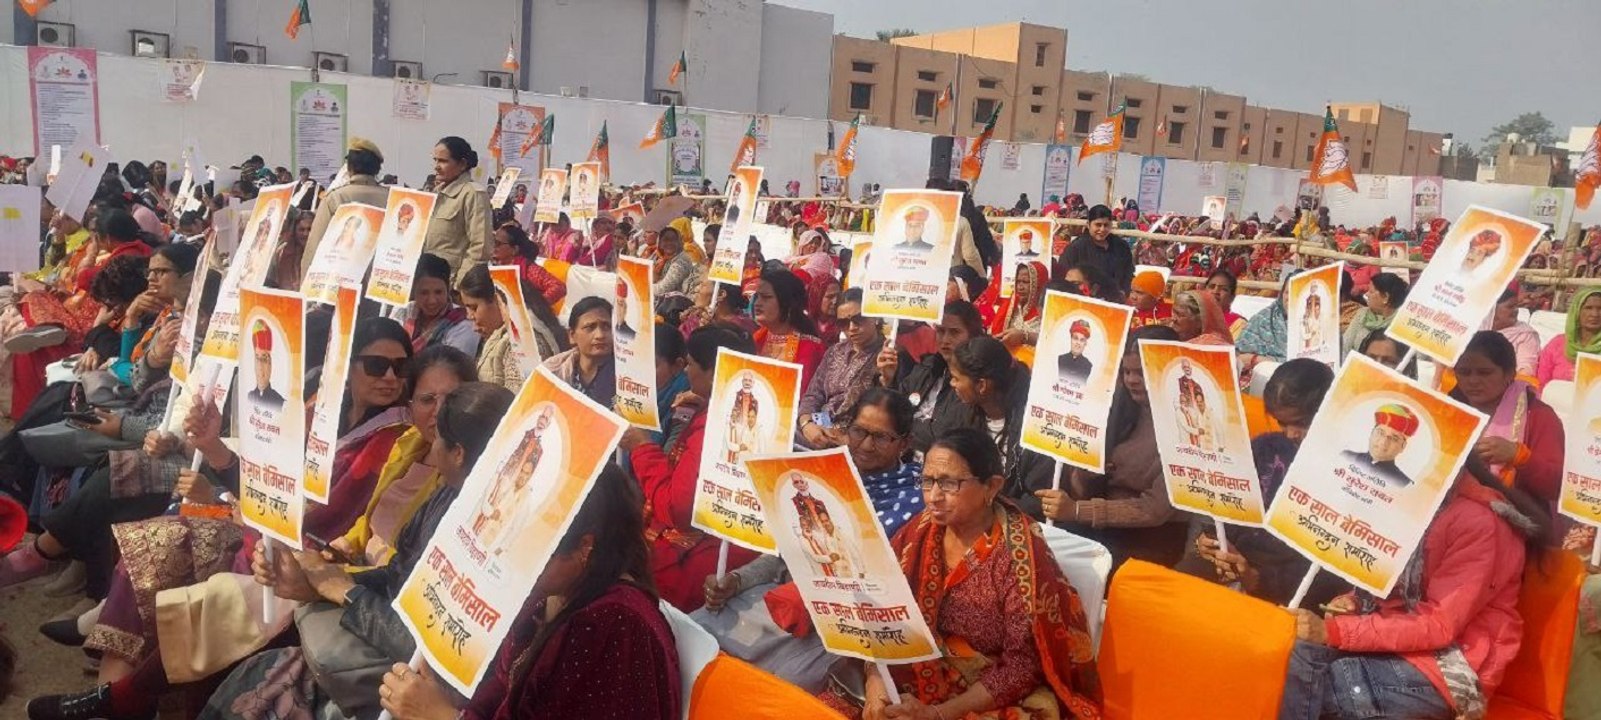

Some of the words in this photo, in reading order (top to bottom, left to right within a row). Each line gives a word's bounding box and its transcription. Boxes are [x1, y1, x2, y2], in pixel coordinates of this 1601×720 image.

[263, 464, 297, 497] बेमिसाल
[1168, 464, 1186, 478] एक
[1207, 468, 1250, 492] बेमिसाल
[1288, 486, 1311, 507] एक
[1310, 497, 1340, 526] साल
[1340, 514, 1402, 559] बेमिसाल
[427, 546, 445, 574] एक
[450, 573, 501, 634] बेमिसाल
[811, 600, 830, 616] एक
[831, 602, 854, 622] साल
[853, 602, 910, 624] बेमिसाल
